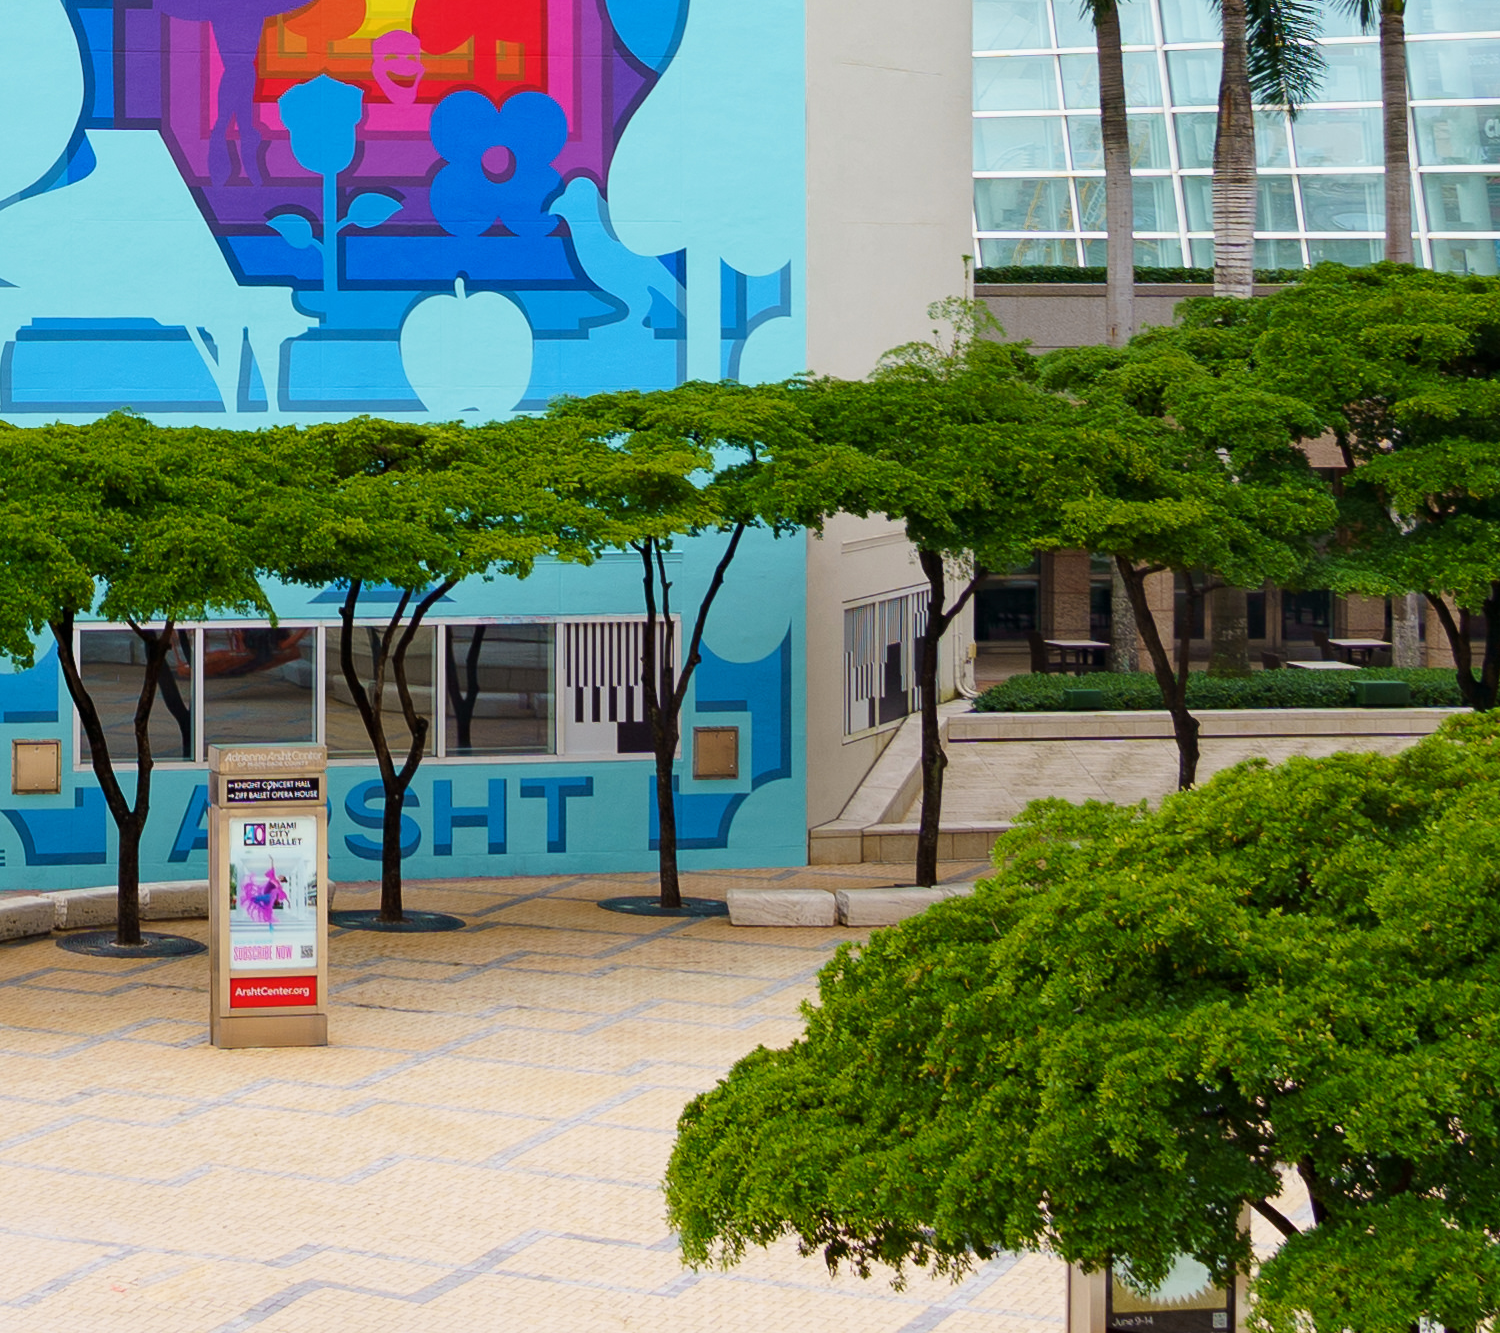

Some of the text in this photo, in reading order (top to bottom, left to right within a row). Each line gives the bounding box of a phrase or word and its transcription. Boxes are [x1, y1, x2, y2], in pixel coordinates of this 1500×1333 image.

[224, 750, 323, 762] Adrienne Arsht Center
[234, 780, 311, 789] KNIGHT CONCERT HALL
[248, 791, 271, 799] BALLET
[271, 790, 294, 799] OPERA
[294, 789, 318, 798] HOUSE
[167, 776, 594, 863] ASHT
[269, 822, 297, 830] MIAMI
[269, 830, 290, 838] CITY
[269, 837, 303, 846] BALLET
[233, 945, 293, 961] SUBSCRIBE NOW
[235, 987, 310, 997] ArshtCenter.org
[1112, 1317, 1134, 1328] June
